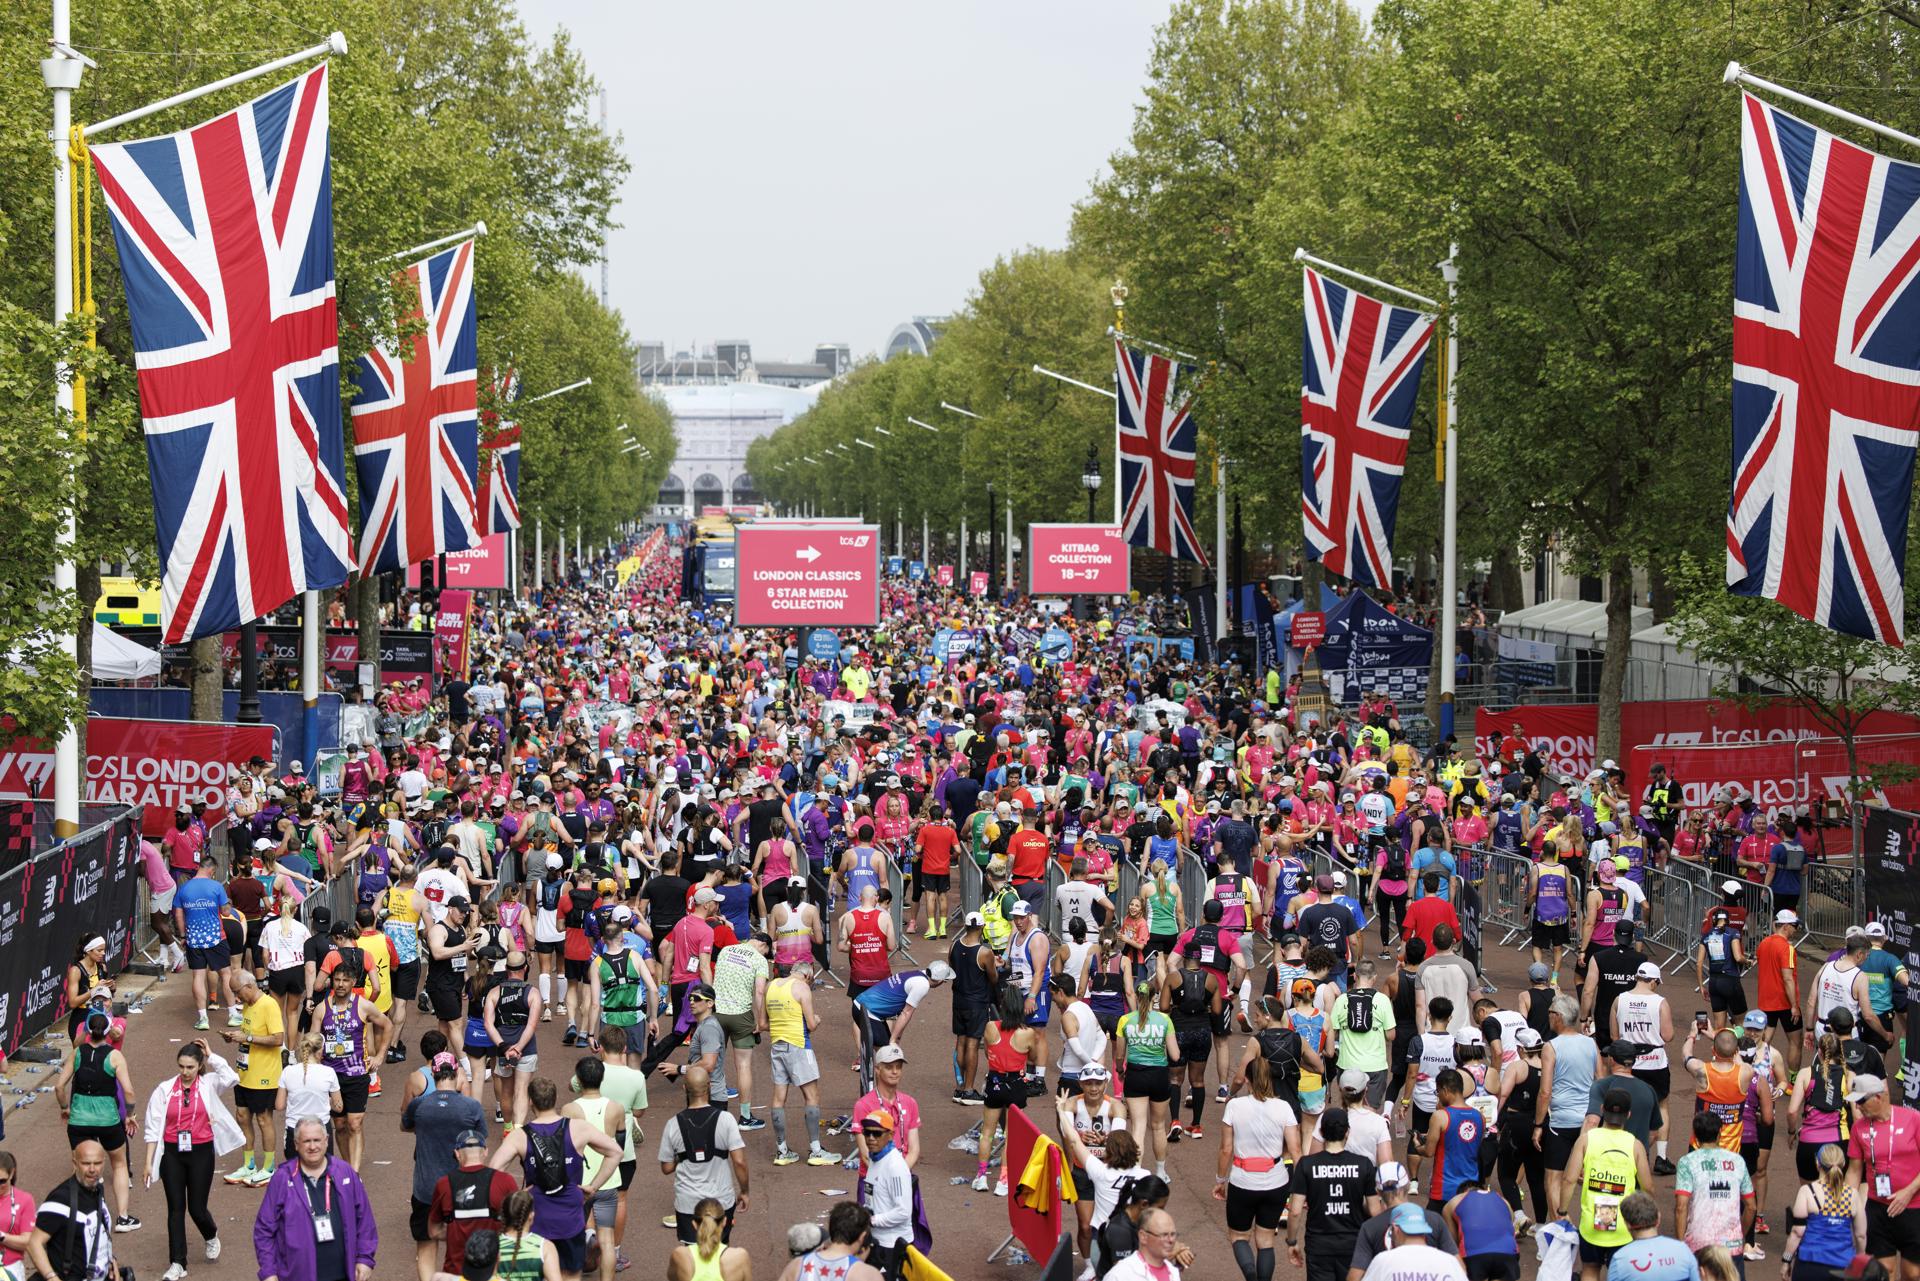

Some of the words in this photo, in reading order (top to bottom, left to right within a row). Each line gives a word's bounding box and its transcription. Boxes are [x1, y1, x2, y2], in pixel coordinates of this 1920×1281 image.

[840, 535, 854, 545] tcs
[1061, 544, 1100, 552] KITBAG
[1049, 555, 1112, 564] COLLECTION
[754, 570, 802, 580] LONDON
[805, 570, 862, 580] CLASSICS
[767, 588, 774, 598] 6
[776, 588, 806, 598] STAR
[809, 588, 848, 598] MEDAL
[772, 600, 843, 609] COLLECTION
[442, 612, 461, 620] 1981
[438, 620, 464, 628] SUITE
[274, 644, 295, 658] tcs
[380, 649, 393, 661] cs
[86, 780, 225, 810] ARATHO
[729, 947, 754, 958] OLIVER
[1127, 1024, 1164, 1037] RUN
[1624, 1022, 1653, 1032] MATT
[1129, 1037, 1162, 1045] OXFAM
[1312, 1165, 1359, 1178] LIBERATE
[1590, 1168, 1626, 1183] Cohen
[1330, 1184, 1343, 1196] LA
[1709, 1191, 1731, 1199] VIVEROS
[1325, 1202, 1350, 1215] JUVE
[1658, 1257, 1675, 1267] TUI
